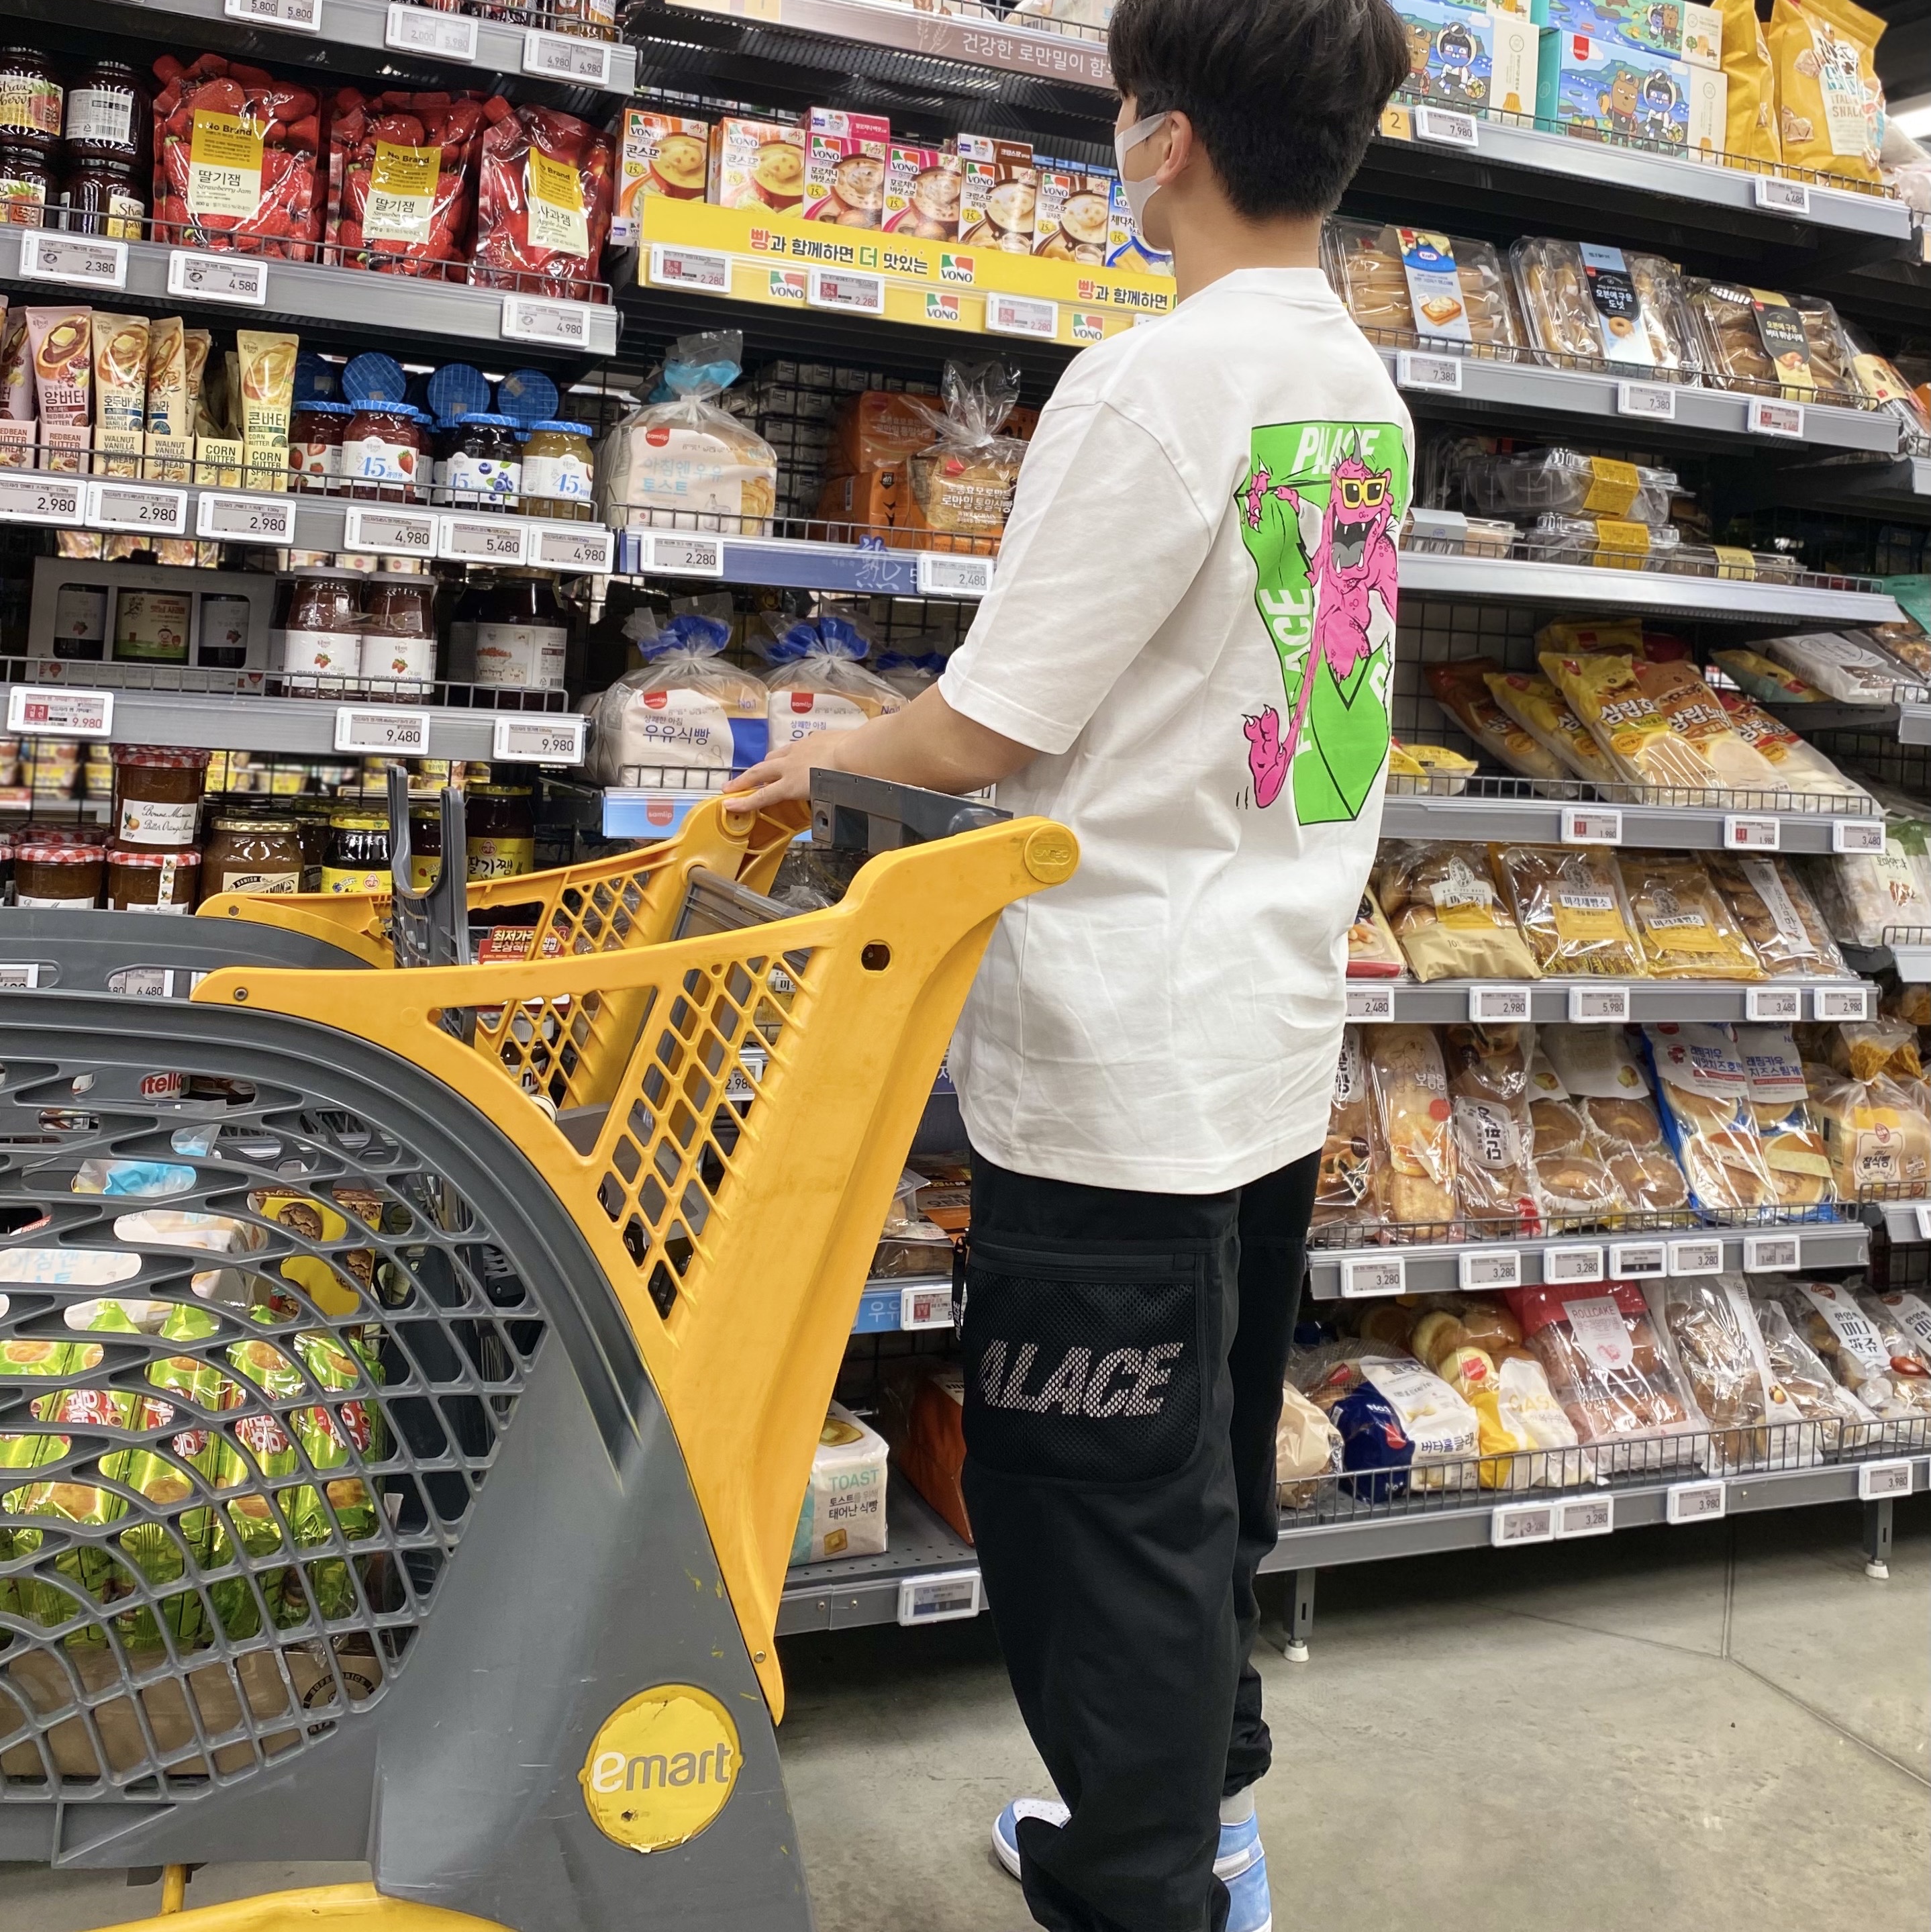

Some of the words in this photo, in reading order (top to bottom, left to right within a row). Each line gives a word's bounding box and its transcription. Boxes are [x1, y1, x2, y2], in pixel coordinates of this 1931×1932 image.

[962, 32, 1012, 59] 건강한
[1017, 44, 1085, 73] 로만밀이
[222, 124, 252, 136] Brand
[729, 136, 758, 148] VONO
[387, 150, 401, 160] No
[402, 154, 430, 165] Brand
[812, 150, 840, 160] VONO
[548, 166, 571, 181] Brand
[891, 162, 918, 173] VONO
[197, 168, 241, 187] 딸기잼
[967, 176, 993, 187] VONO
[1043, 186, 1069, 197] VONO
[375, 196, 415, 213] 딸기잼
[750, 228, 787, 253] 빵과
[792, 238, 854, 264] 함께하면
[860, 246, 878, 269] 더
[883, 252, 928, 275] 맛있는
[941, 269, 973, 283] VONO
[771, 286, 804, 299] VONO
[1078, 279, 1109, 303] 빵과
[1113, 287, 1168, 311] 함께하면
[926, 308, 959, 322] VONO
[1073, 327, 1103, 341] VONO
[44, 390, 85, 405] 앙버터
[248, 412, 287, 427] 콘버터
[104, 435, 136, 444] WALNUT
[104, 442, 135, 450] VANILLA
[155, 440, 186, 449] WALNUT
[155, 446, 186, 456] VANILLA
[205, 445, 236, 456] CORN
[252, 451, 281, 463] CORN
[642, 458, 690, 478] 아침엔
[696, 463, 724, 482] 우유
[642, 478, 689, 495] 토스트
[37, 497, 76, 513] 2,980
[139, 506, 177, 522] 2,980
[250, 516, 286, 532] 2,980
[395, 531, 430, 545] 4,980
[485, 538, 519, 554] 5,480
[573, 547, 606, 562] 4,980
[685, 552, 717, 566] 2,280
[644, 714, 667, 725] 상쾌한
[669, 716, 683, 726] 아침
[790, 720, 811, 730] 상쾌한
[812, 721, 827, 730] 아침
[387, 729, 421, 744] 9,480
[642, 724, 711, 746] 우유식빵
[541, 739, 575, 753] 9,980
[648, 810, 673, 820] samlip
[1746, 1056, 1785, 1067] 래핑카우
[1572, 1304, 1615, 1320] ROLLCAKE
[1840, 1322, 1871, 1336] 미니
[828, 1468, 880, 1493] TOAST
[828, 1503, 858, 1521] 태어난
[859, 1499, 879, 1515] 식빵
[591, 1743, 731, 1794] emart
